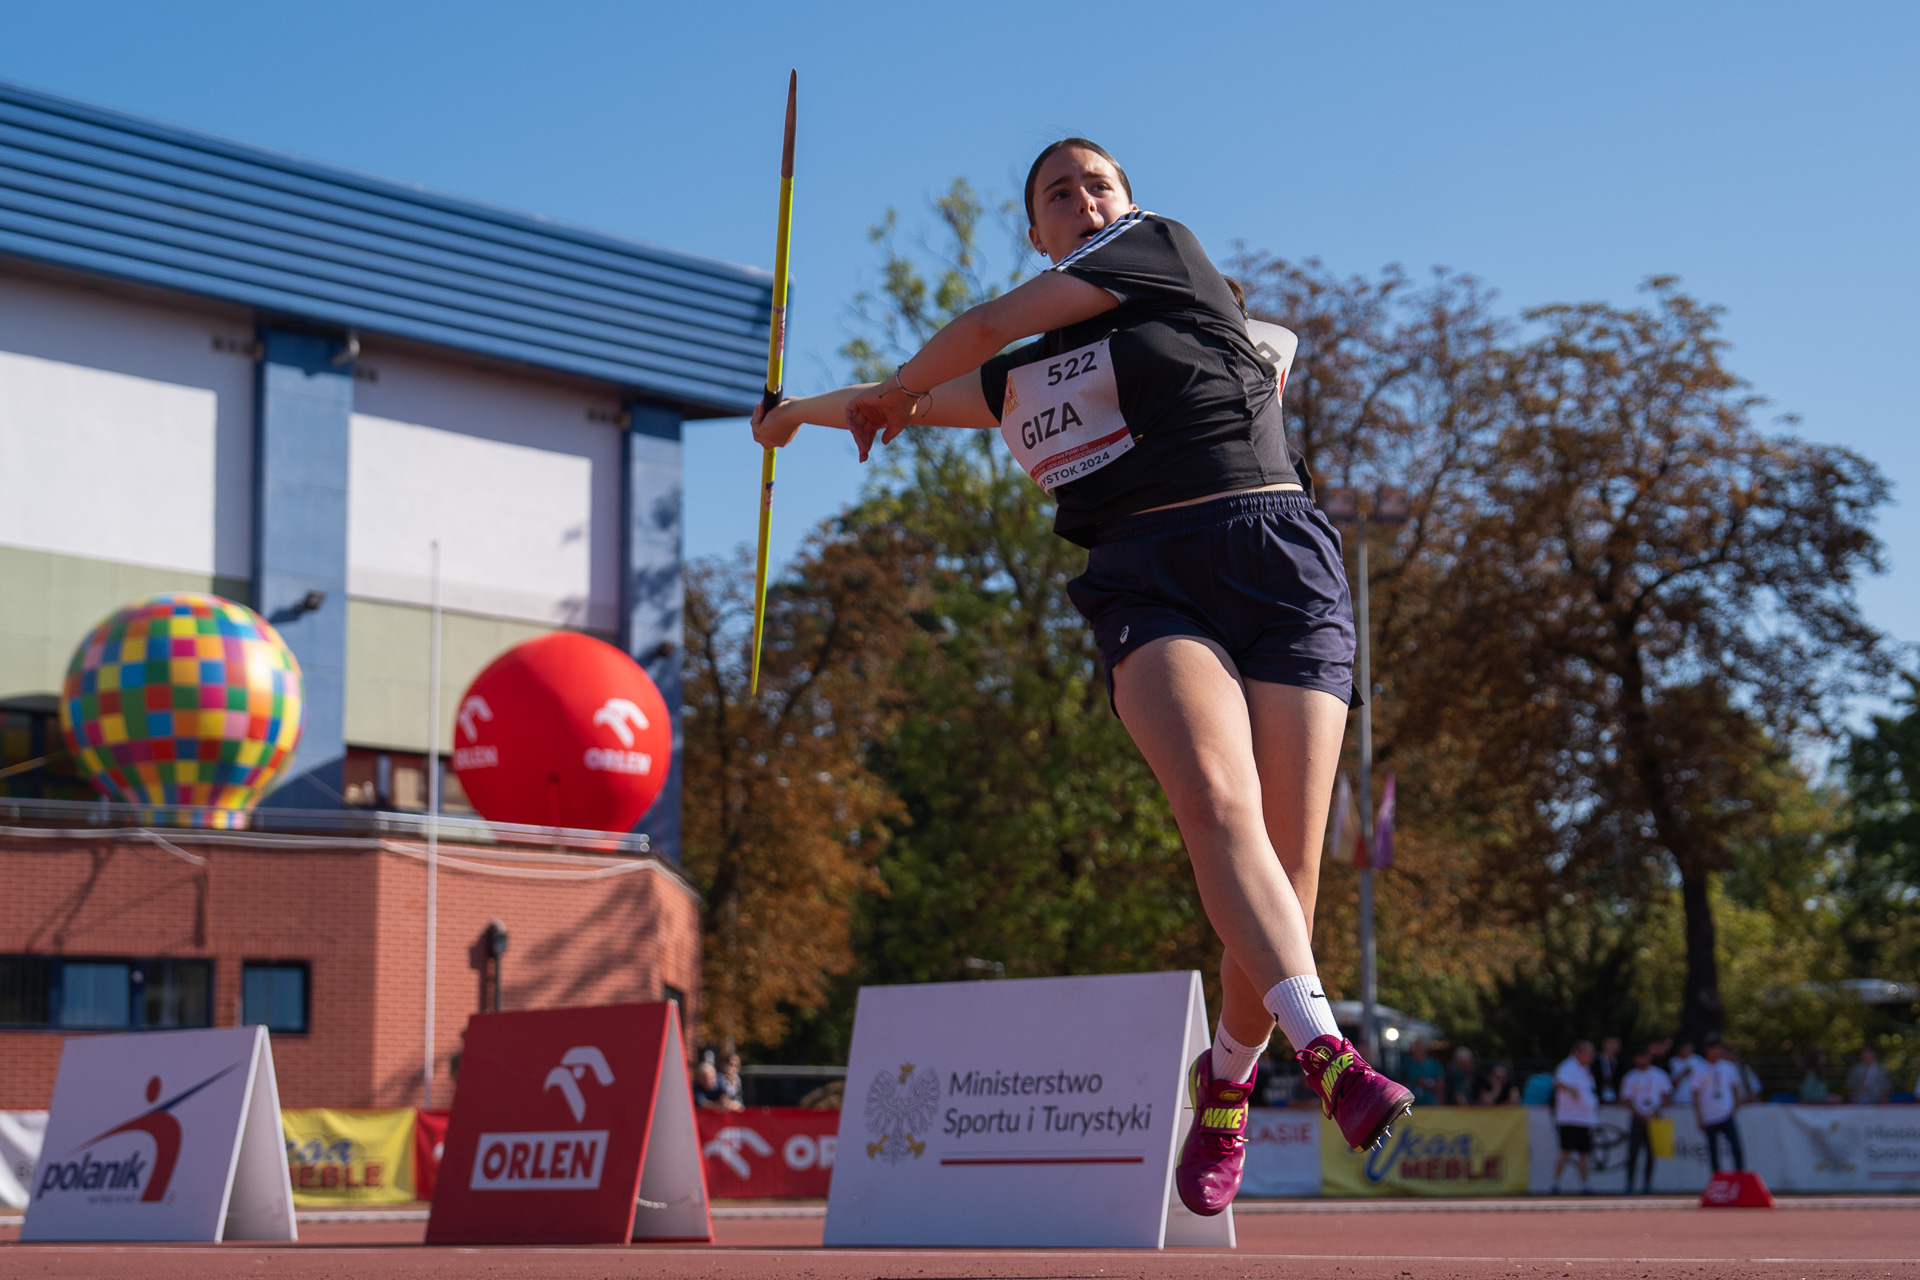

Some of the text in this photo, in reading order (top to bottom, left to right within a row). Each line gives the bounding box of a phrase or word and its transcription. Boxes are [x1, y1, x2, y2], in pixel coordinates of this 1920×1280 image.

[1047, 351, 1097, 386] 522
[1021, 402, 1083, 450] GIZA
[1079, 451, 1111, 471] 2024
[583, 747, 652, 776] ORLEN
[949, 1069, 1104, 1097] Ministerstwo
[1321, 1052, 1354, 1103] NIKE
[943, 1103, 1153, 1138] Sportu i Turystyki
[1201, 1107, 1245, 1129] NIKE
[36, 1151, 146, 1200] polanik
[482, 1141, 598, 1180] ORLEN
[1400, 1154, 1503, 1181] MEBLE
